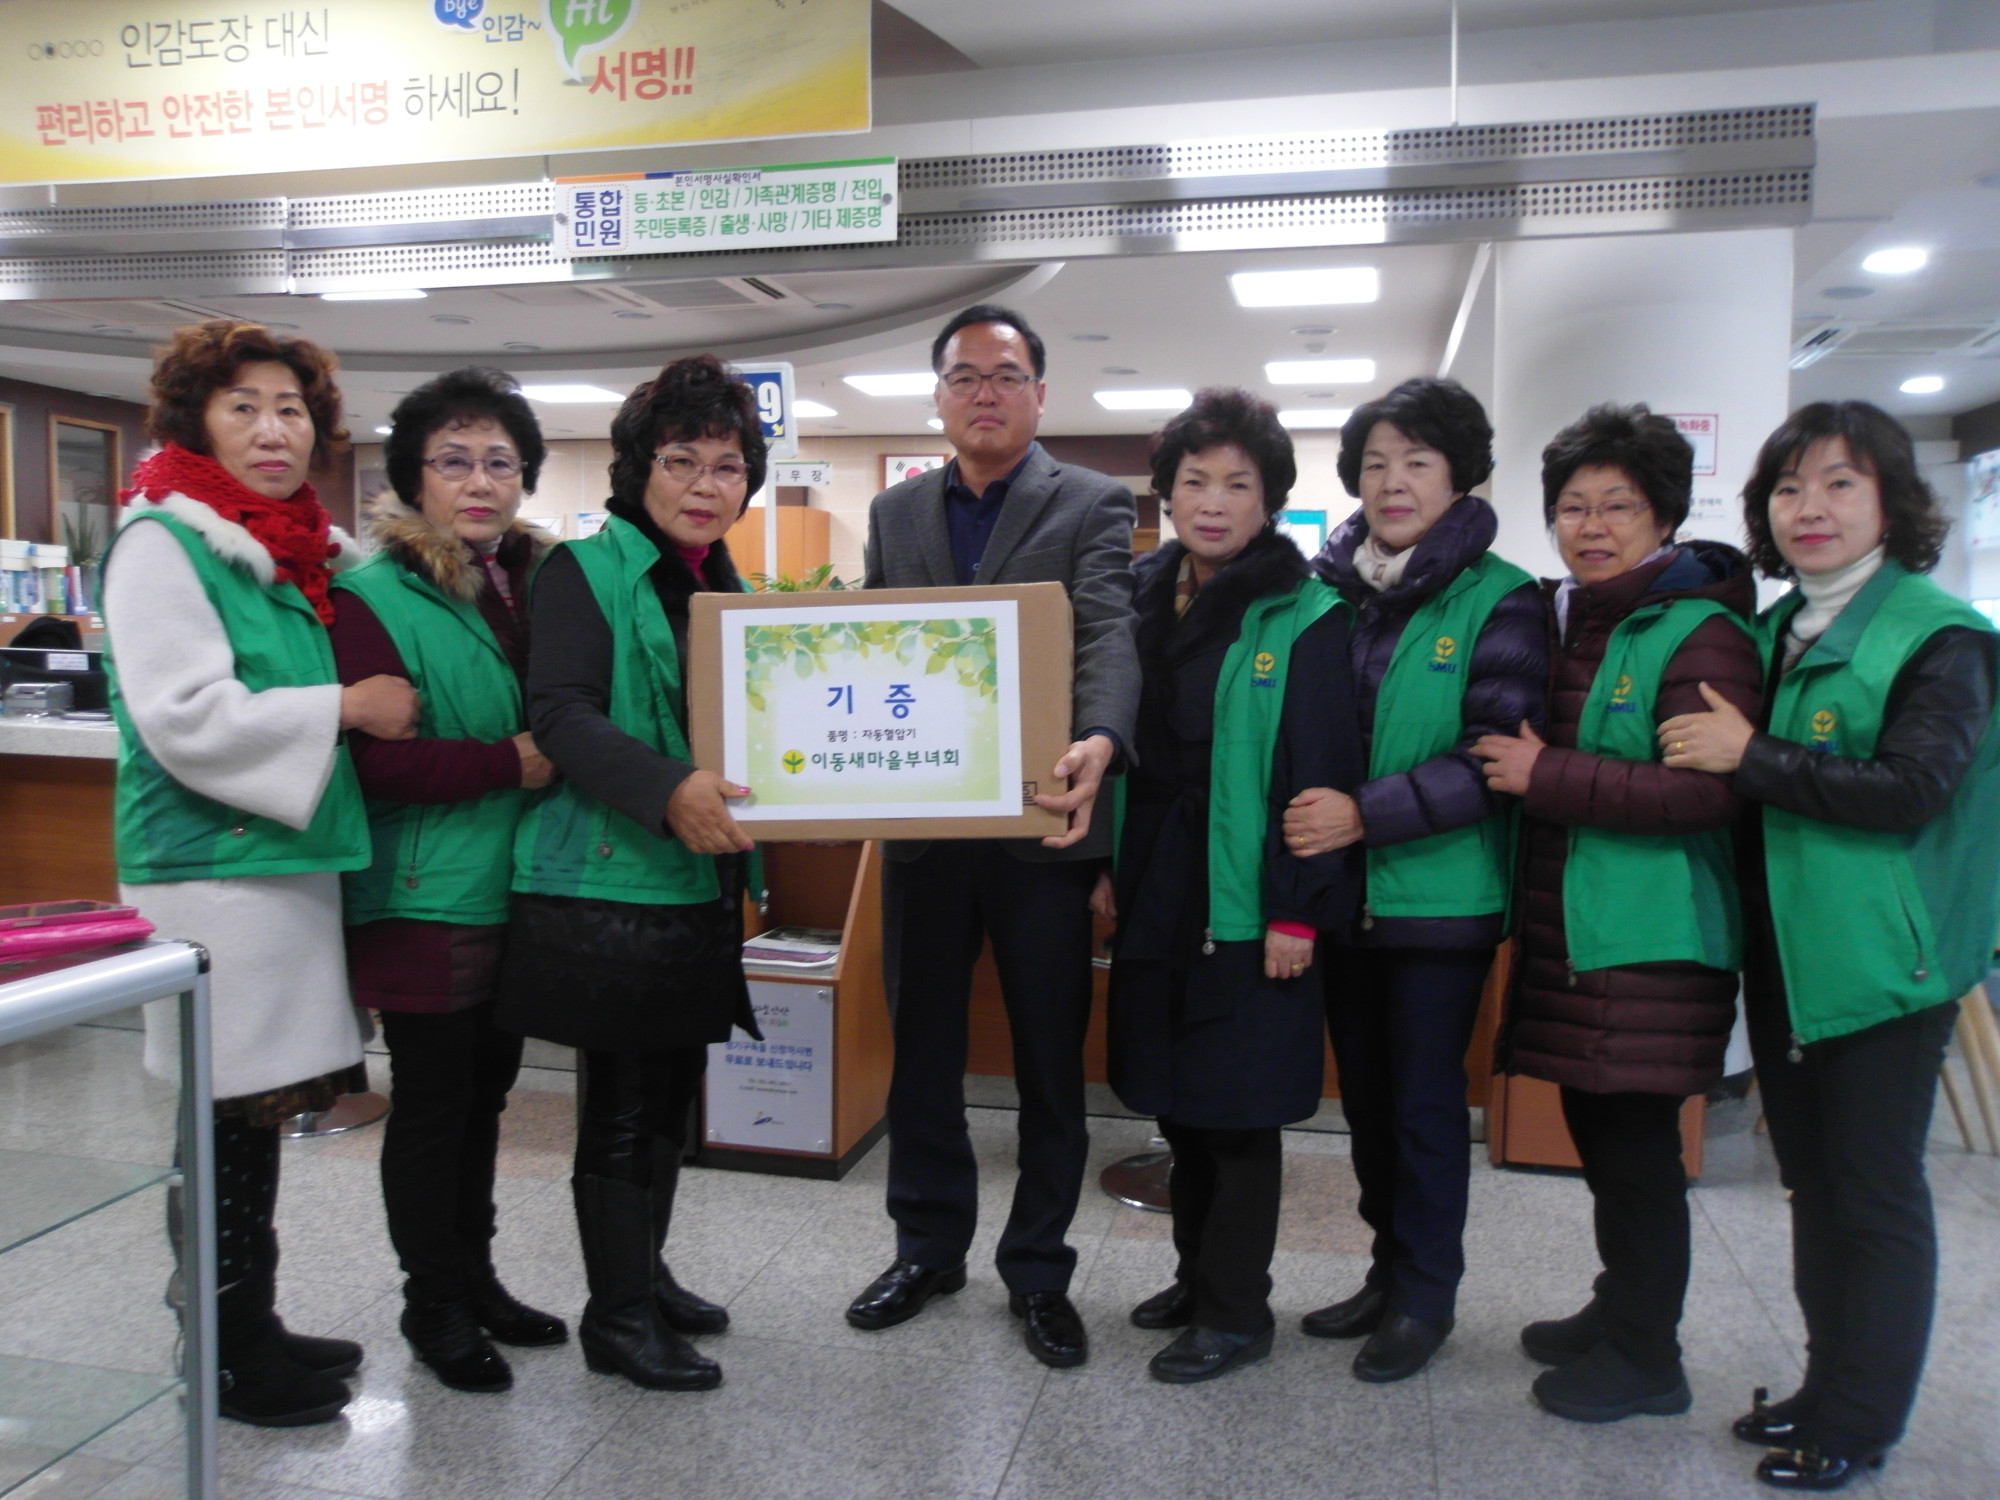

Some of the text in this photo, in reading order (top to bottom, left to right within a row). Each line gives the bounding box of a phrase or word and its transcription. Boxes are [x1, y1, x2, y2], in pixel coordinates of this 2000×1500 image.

[445, 0, 479, 18] Bye
[120, 8, 329, 68] 인감도장 대신
[588, 46, 695, 101] 서명!!
[35, 68, 519, 146] 편리하고 안전한 본인서명 하세요!
[675, 172, 760, 187] 본인서명사실확인서
[700, 187, 730, 209] 인감
[744, 181, 836, 206] 가족관계증명
[852, 178, 882, 201] 전입
[574, 190, 623, 219] 통합
[575, 219, 621, 247] 민원
[634, 216, 707, 239] 주민등록증
[802, 208, 831, 230] 기타
[836, 206, 882, 229] 제증명
[1428, 661, 1458, 674] SMU
[1250, 677, 1276, 689] SMU
[827, 730, 848, 743] 품명
[862, 728, 917, 742] 자동혈압기
[811, 749, 960, 773] 이동새마을부녀회
